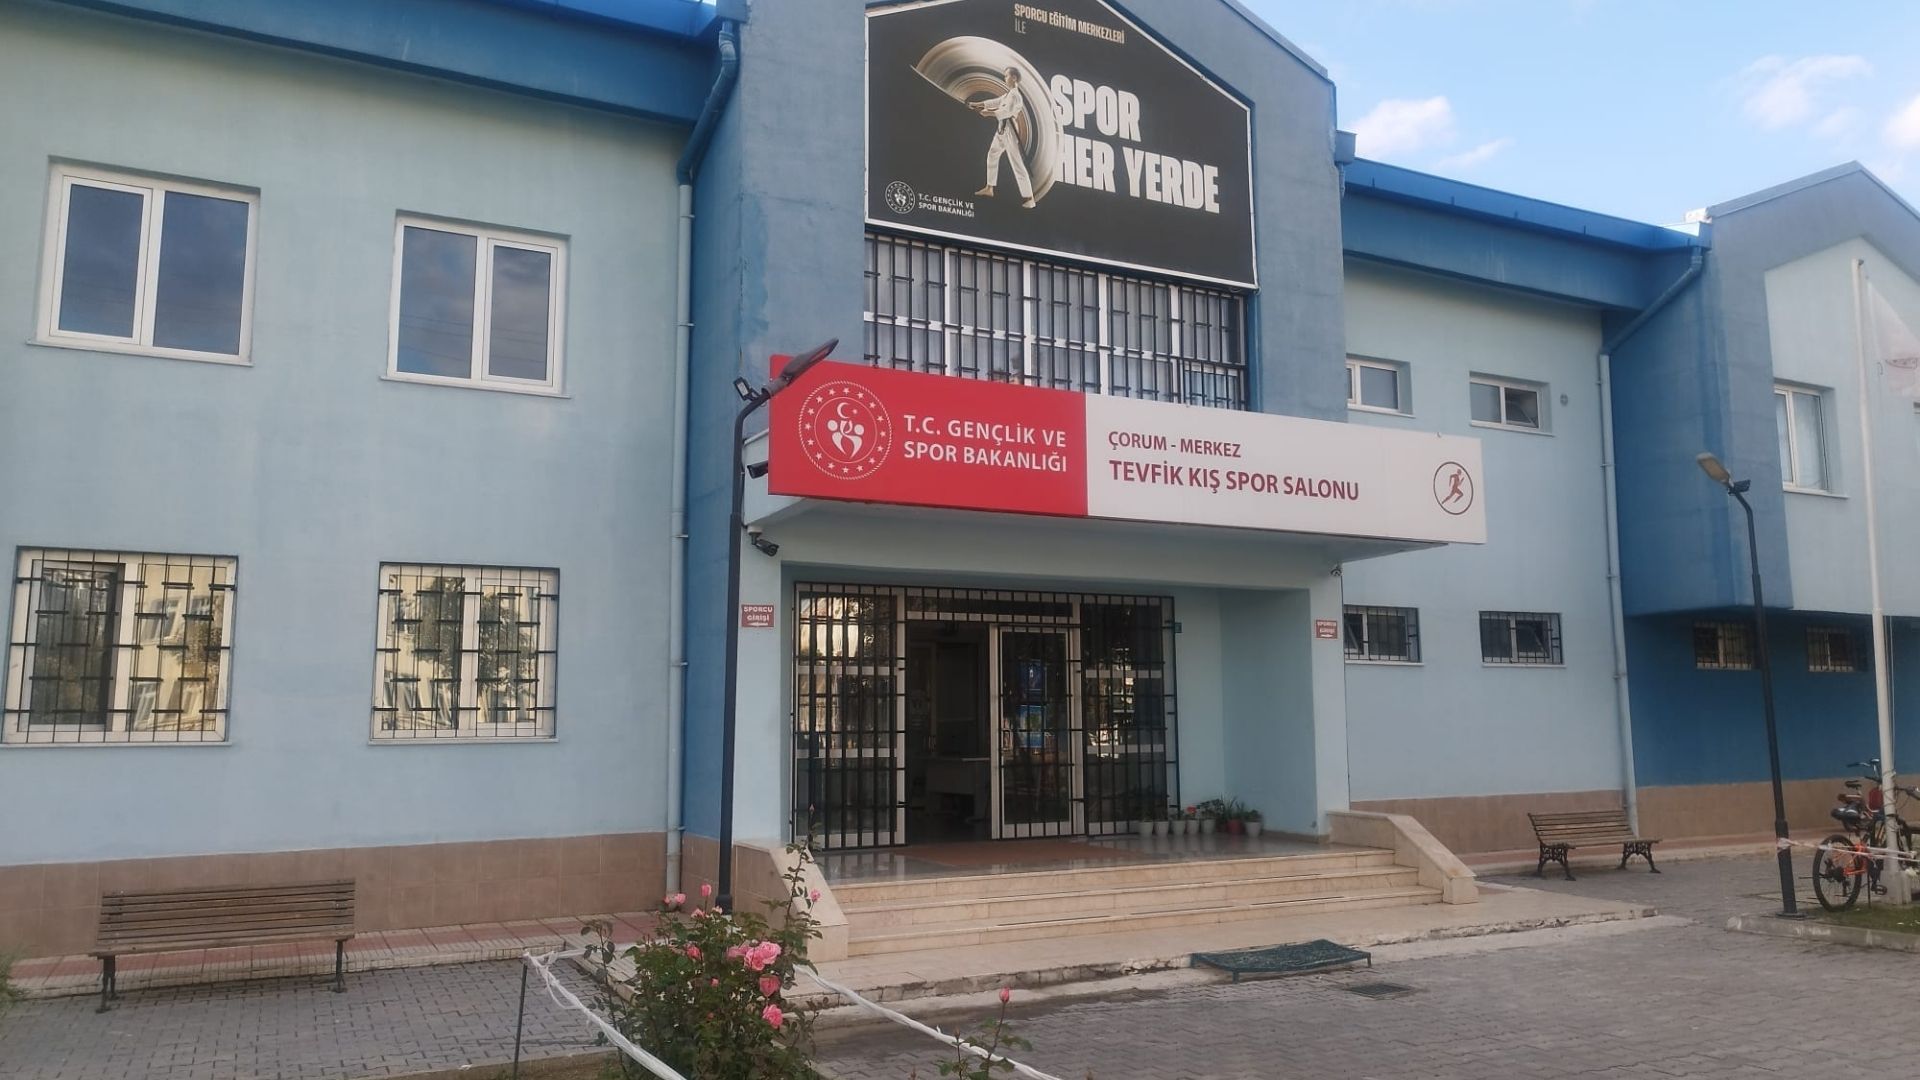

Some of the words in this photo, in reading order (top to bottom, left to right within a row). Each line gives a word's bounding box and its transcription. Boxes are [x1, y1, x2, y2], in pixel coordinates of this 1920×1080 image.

[1014, 3, 1047, 23] SPORCU
[1049, 11, 1076, 31] EĞİTİM
[1078, 20, 1124, 44] MERKEZLERİ
[1050, 74, 1141, 142] SPOR
[1055, 133, 1116, 193] HER
[1122, 146, 1219, 214] YERDE
[918, 202, 937, 212] SPOR
[965, 202, 974, 210] VE
[903, 414, 941, 435] T.C.
[947, 419, 1036, 446] GENÇLİK
[1042, 429, 1066, 448] VE
[1108, 431, 1167, 451] ÇORUM
[1180, 438, 1241, 458] MERKEZ
[904, 440, 957, 462] SPOR
[963, 446, 1067, 472] BAKANLIĞI
[1109, 459, 1183, 486] TEVFİK
[1188, 467, 1221, 494] KIŞ
[1226, 470, 1278, 494] SPOR
[1283, 475, 1359, 501] SALONU
